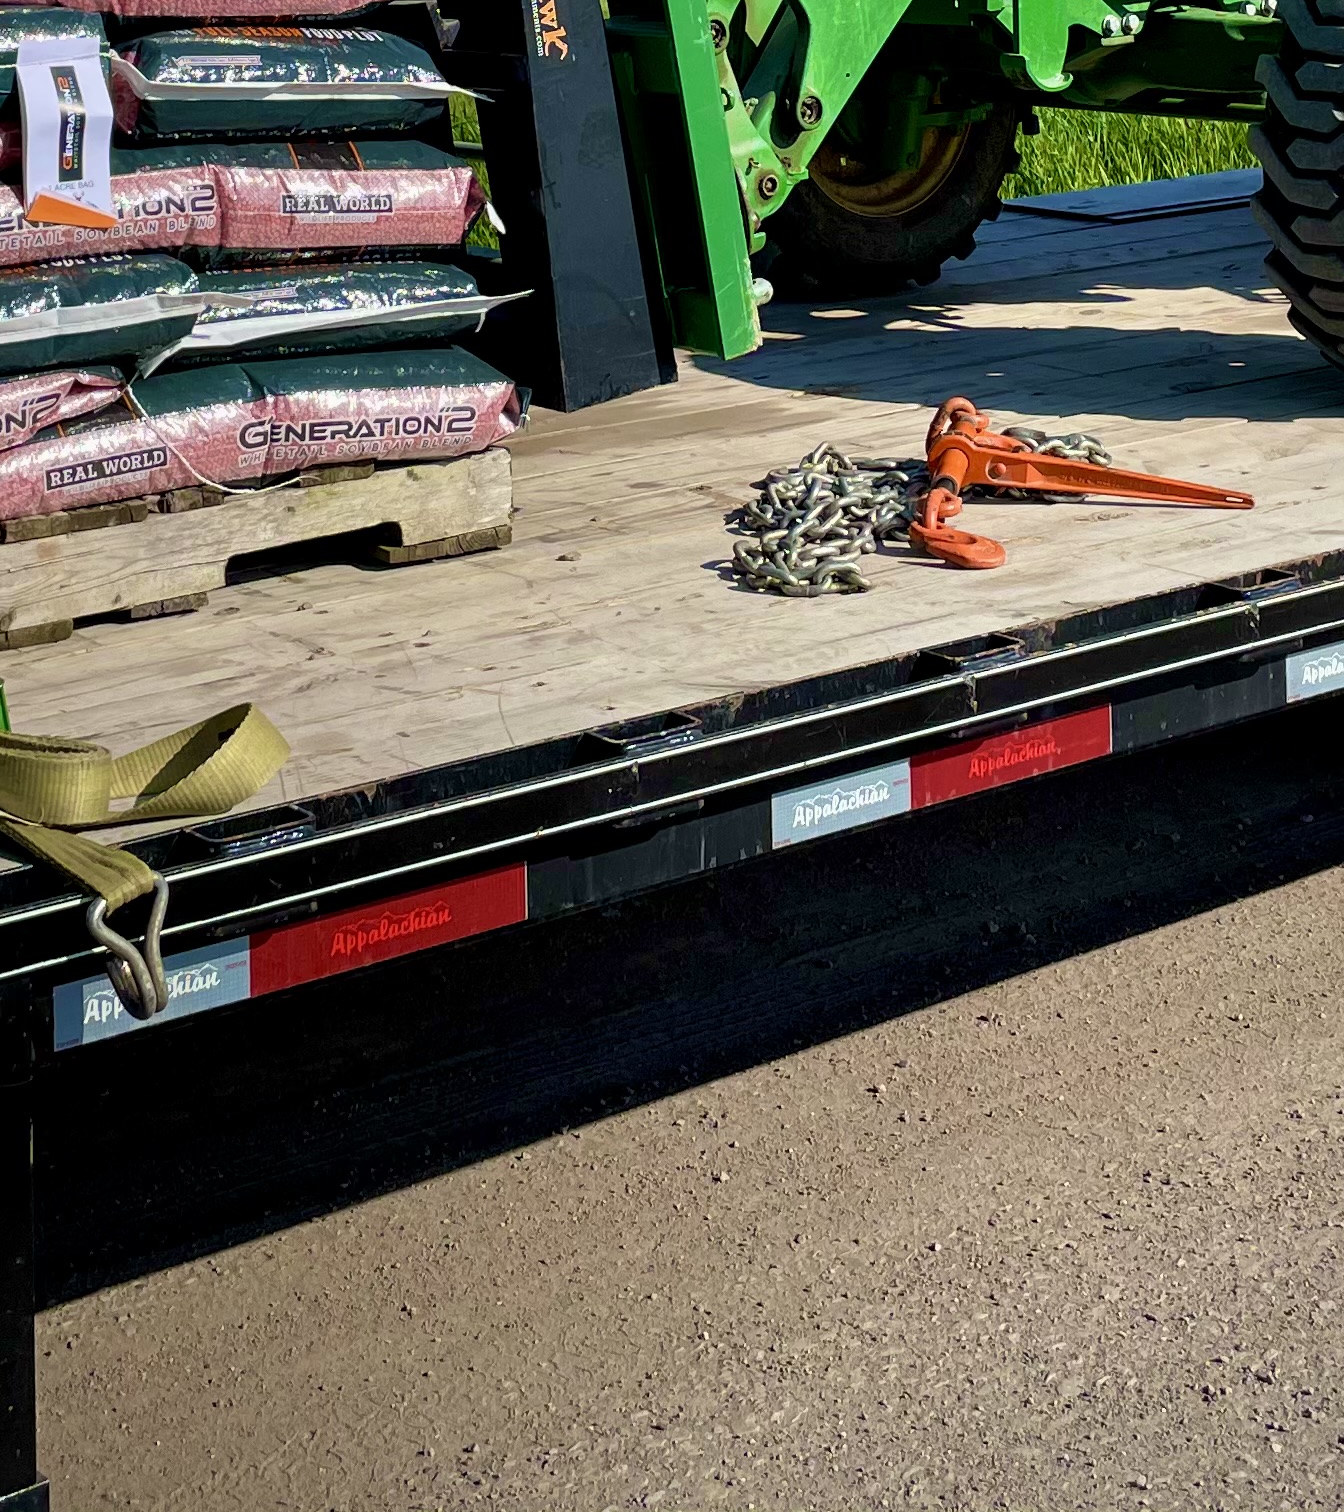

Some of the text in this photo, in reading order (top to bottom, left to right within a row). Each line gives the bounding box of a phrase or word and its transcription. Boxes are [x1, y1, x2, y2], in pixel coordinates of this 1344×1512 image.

[346, 29, 384, 41] PLOT
[77, 180, 94, 189] BAG
[285, 193, 391, 212] REAL WORLD
[75, 222, 158, 243] SOYBEAN
[239, 405, 477, 450] GENERATION2
[422, 434, 473, 449] BLEND
[49, 449, 166, 487] REAL WORLD
[968, 740, 1061, 780] Appalachian
[793, 784, 891, 829] Appalachian
[330, 904, 453, 958] Appalachian
